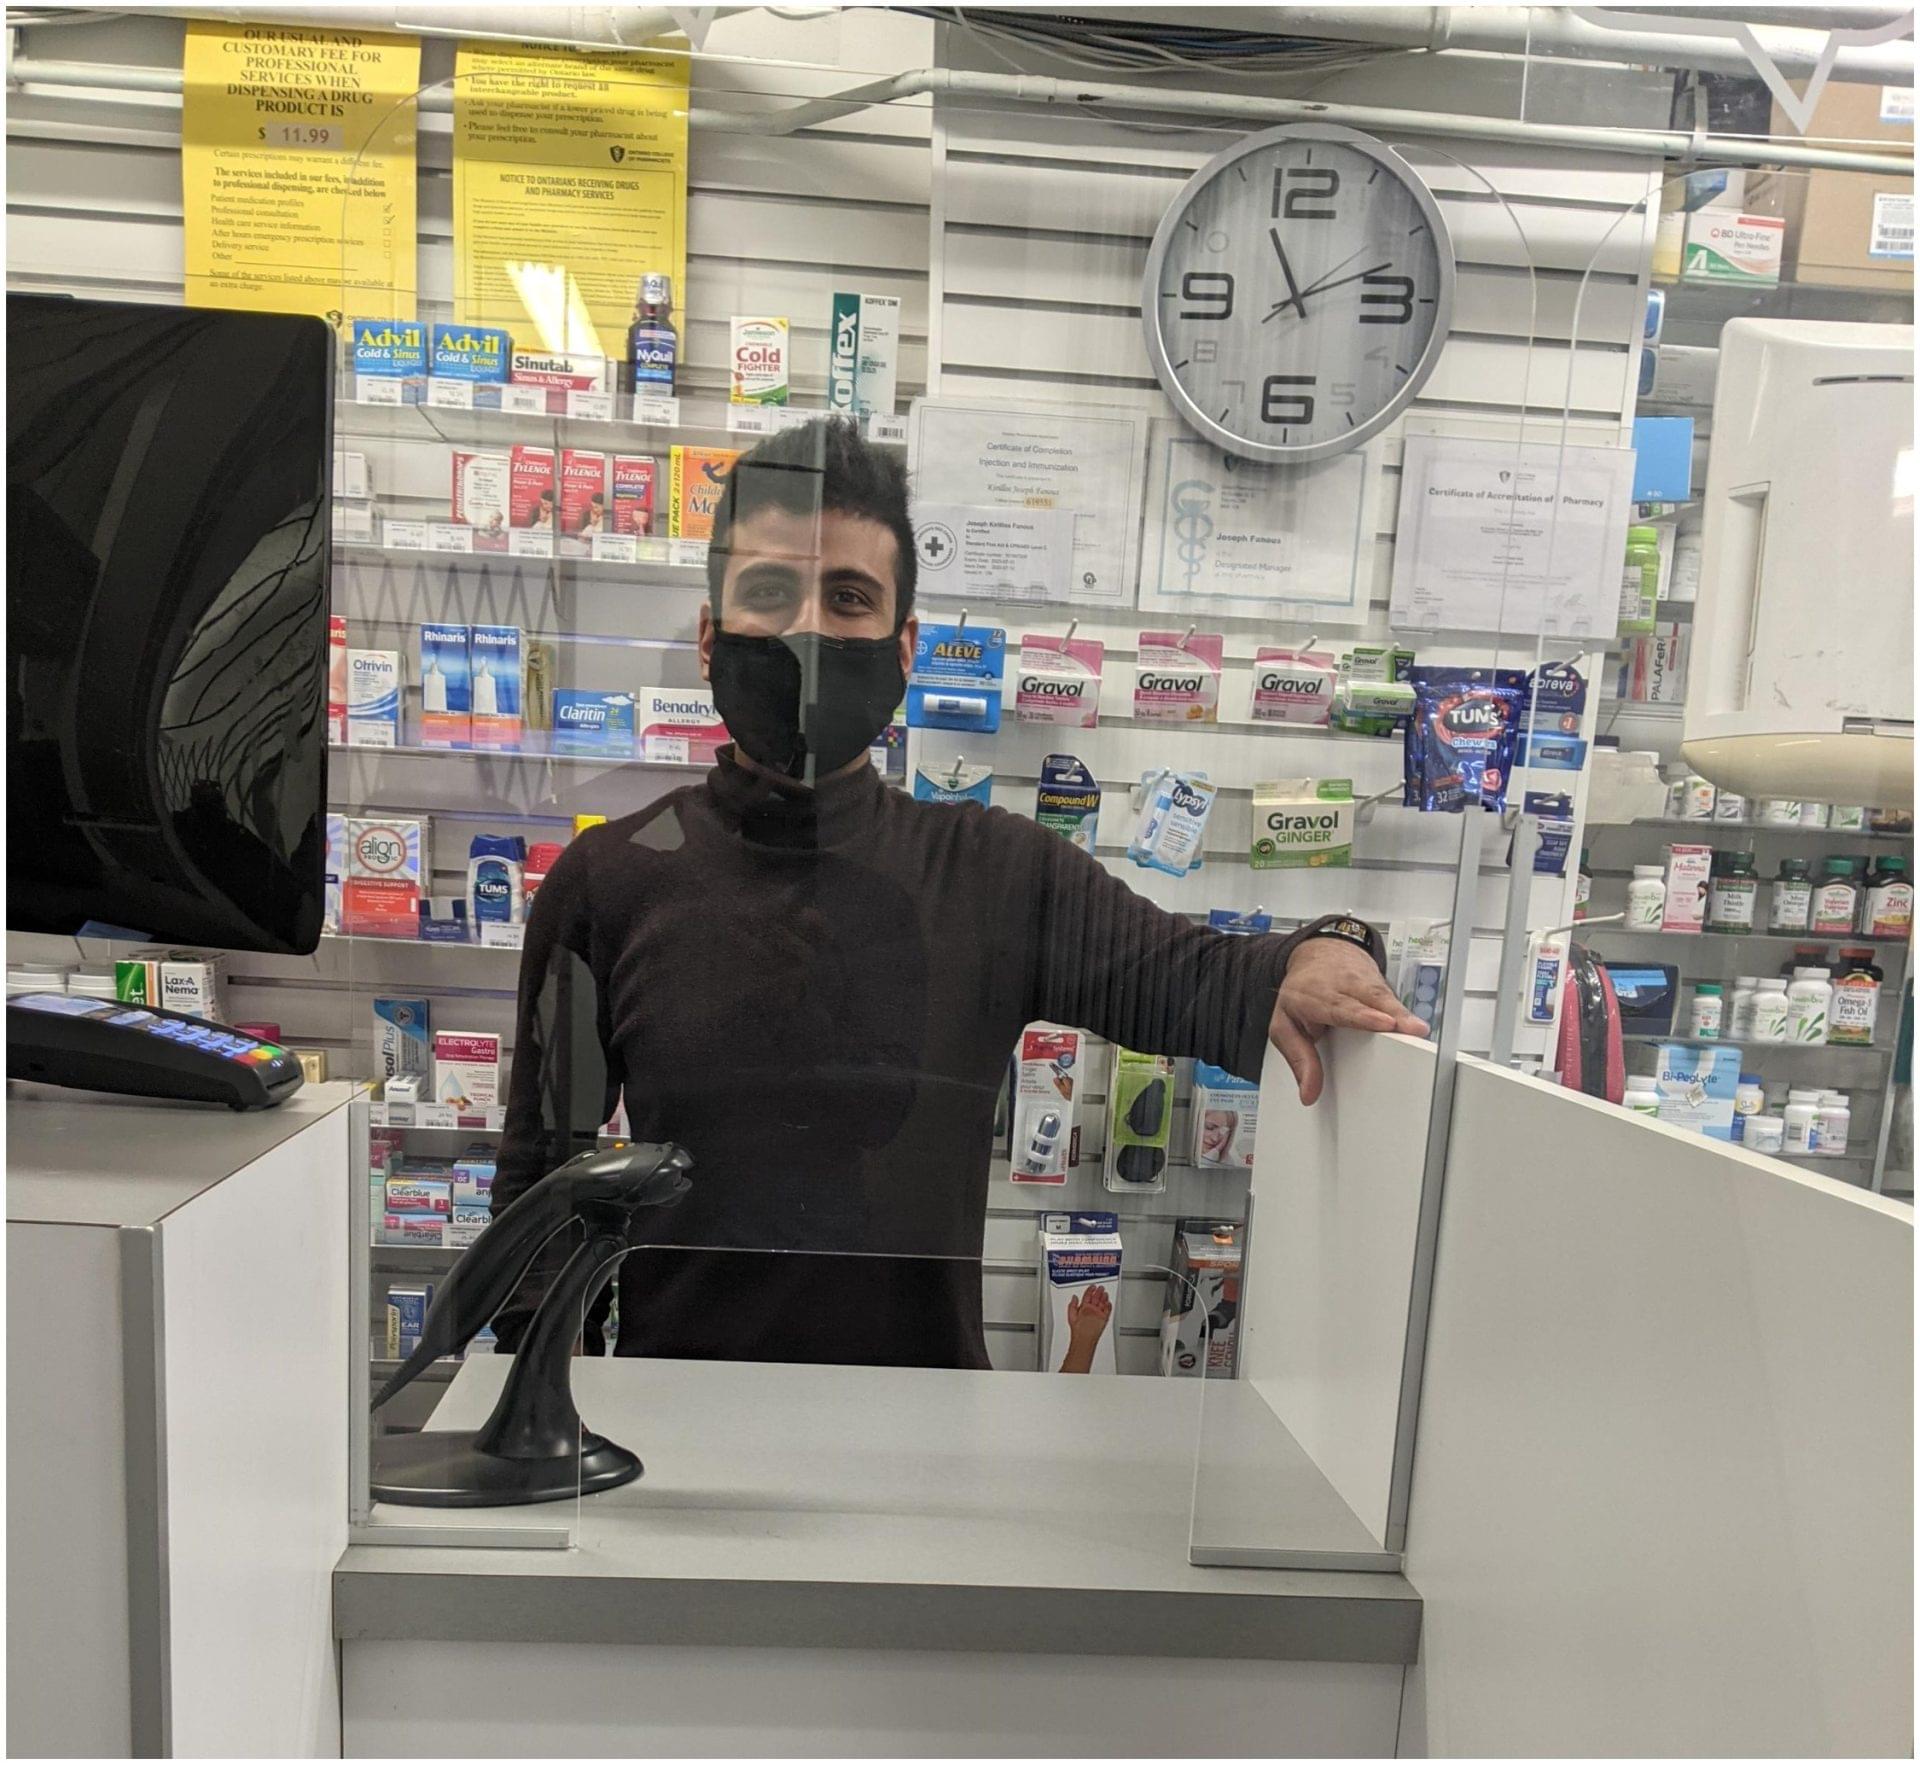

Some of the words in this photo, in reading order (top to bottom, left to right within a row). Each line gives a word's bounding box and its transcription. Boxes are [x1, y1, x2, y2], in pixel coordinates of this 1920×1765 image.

[244, 29, 275, 42] OUR
[333, 35, 362, 47] AND
[222, 41, 315, 59] CUSTOMARY
[320, 48, 348, 60] FEE
[351, 50, 381, 63] FOR
[246, 57, 358, 75] PROFESSIONAL
[240, 71, 312, 85] SERVICES
[315, 74, 361, 89] WHEN
[511, 75, 525, 86] the
[528, 76, 549, 88] right
[552, 78, 561, 88] to
[564, 80, 595, 91] request
[227, 83, 315, 101] DISPENSING
[317, 90, 327, 101] A
[333, 90, 373, 104] DRUG
[470, 86, 540, 97] interchangeable
[256, 99, 329, 116] PRODUCT
[331, 105, 344, 117] IS
[468, 121, 495, 131] Please
[258, 127, 266, 140] $
[281, 127, 329, 143] 11.99
[215, 166, 230, 176] The
[231, 168, 262, 178] services
[264, 169, 298, 180] included
[213, 179, 221, 187] to
[223, 179, 270, 190] professional
[500, 173, 524, 184] NOTICE
[527, 175, 536, 184] TO
[537, 175, 576, 187] ONTARIANS
[577, 178, 614, 189] RECEIVING
[615, 180, 640, 190] DRUGS
[525, 187, 540, 196] AND
[541, 187, 581, 198] PHARMACY
[582, 190, 614, 200] SERVICES
[1271, 167, 1340, 220] 12
[1721, 229, 1733, 239] BD
[211, 251, 232, 260] Other
[1180, 271, 1235, 321] 9
[1358, 275, 1415, 325] 3
[357, 328, 420, 348] Advil
[438, 332, 499, 355] Advil
[356, 347, 382, 359] Cold
[382, 348, 391, 359] &
[392, 348, 420, 360] Sinus
[636, 348, 673, 363] NyQuil
[736, 347, 781, 363] Cold
[1192, 339, 1218, 363] 8
[436, 351, 460, 363] Cold
[461, 353, 469, 364] &
[471, 354, 498, 367] Sinus
[514, 356, 574, 373] Sinutab
[737, 363, 781, 372] FIGHTER
[538, 375, 545, 383] &
[545, 375, 574, 389] Allergy
[1260, 374, 1317, 425] 6
[512, 462, 552, 475] TYLENOL
[564, 465, 602, 478] TYLENOL
[1012, 460, 1027, 469] and
[615, 470, 651, 482] TYLENOL
[1428, 487, 1474, 499] Certificate
[1476, 489, 1486, 499] of
[1544, 494, 1554, 504] of
[1562, 495, 1605, 508] Pharmacy
[672, 496, 681, 523] PACK
[1216, 532, 1248, 544] Joseph
[424, 631, 466, 643] Rhinaris
[474, 633, 517, 645] Rhinaris
[932, 641, 983, 659] ALEVE
[353, 659, 393, 673] Otrivin
[1022, 676, 1084, 697] Gravol
[1138, 672, 1203, 692] Gravol
[1261, 673, 1323, 694] Gravol
[560, 704, 606, 721] Claritin
[1449, 708, 1500, 726] TUMS
[1039, 792, 1087, 806] Compound
[1086, 793, 1099, 808] W
[1437, 790, 1448, 804] 32
[1267, 811, 1339, 831] Gravol
[1276, 831, 1331, 843] GINGER
[361, 836, 401, 864] align
[354, 879, 384, 888] DIGESTIVE
[384, 880, 409, 889] SUPPORT
[479, 884, 508, 894] TUMS
[1886, 896, 1909, 909] Zinc
[165, 974, 195, 986] Lax-A
[165, 984, 199, 996] Nema
[1839, 1007, 1856, 1015] Fish
[1856, 1008, 1869, 1016] Oil
[438, 1037, 496, 1047] ELECTROLYTE
[471, 1046, 496, 1055] Gastro
[1662, 1070, 1719, 1086] Bi-PegLyte
[391, 1188, 431, 1197] Clearblue
[456, 1214, 491, 1224] Clearbl
